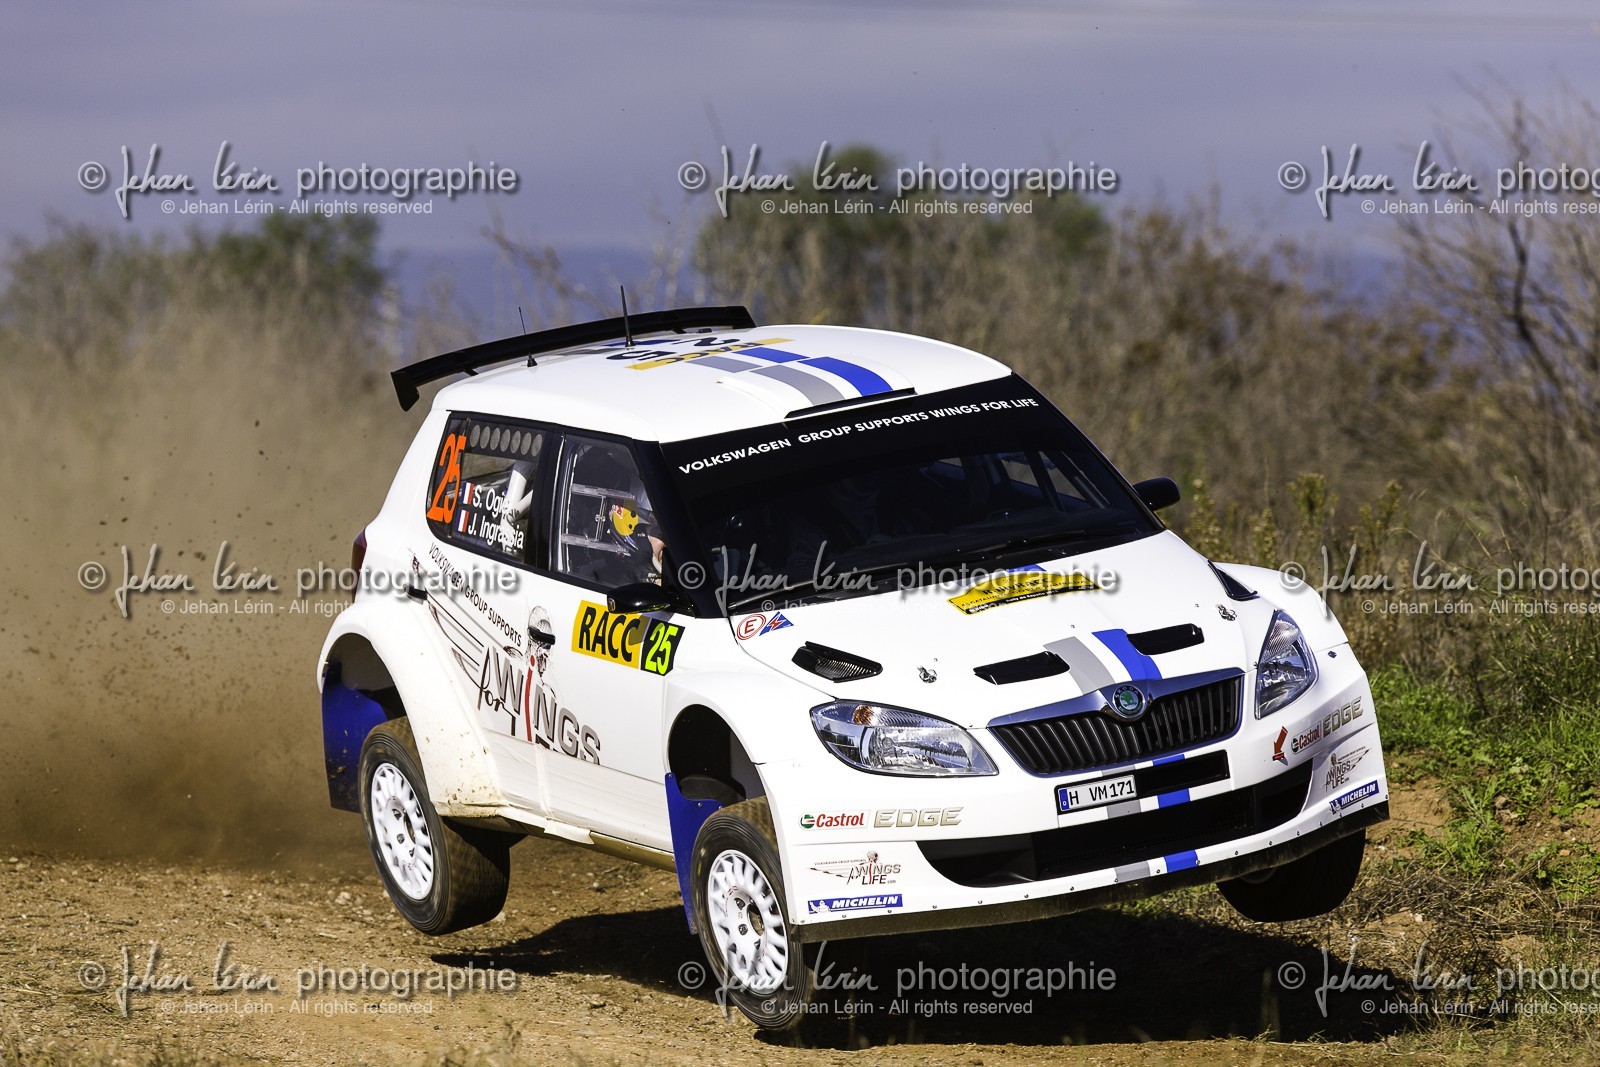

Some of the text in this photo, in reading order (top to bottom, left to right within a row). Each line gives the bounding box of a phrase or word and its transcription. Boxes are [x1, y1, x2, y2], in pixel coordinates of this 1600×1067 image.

[678, 398, 1040, 475] VOLKSWAGEN GROUP SUPPORTS WINGS FOR LIFE
[426, 433, 467, 524] 25
[472, 484, 483, 509] S.
[467, 512, 478, 536] J.
[428, 541, 523, 648] VOLKSWAGEN GROUP SUPPORTS
[578, 605, 679, 675] RACC 25
[1298, 696, 1364, 750] Castrol EDGE
[1069, 790, 1080, 806] H
[1340, 783, 1377, 806] MICHELIN
[816, 806, 965, 829] Castrol EDGE
[861, 874, 888, 886] LIFE
[831, 896, 899, 909] MICHELIN
